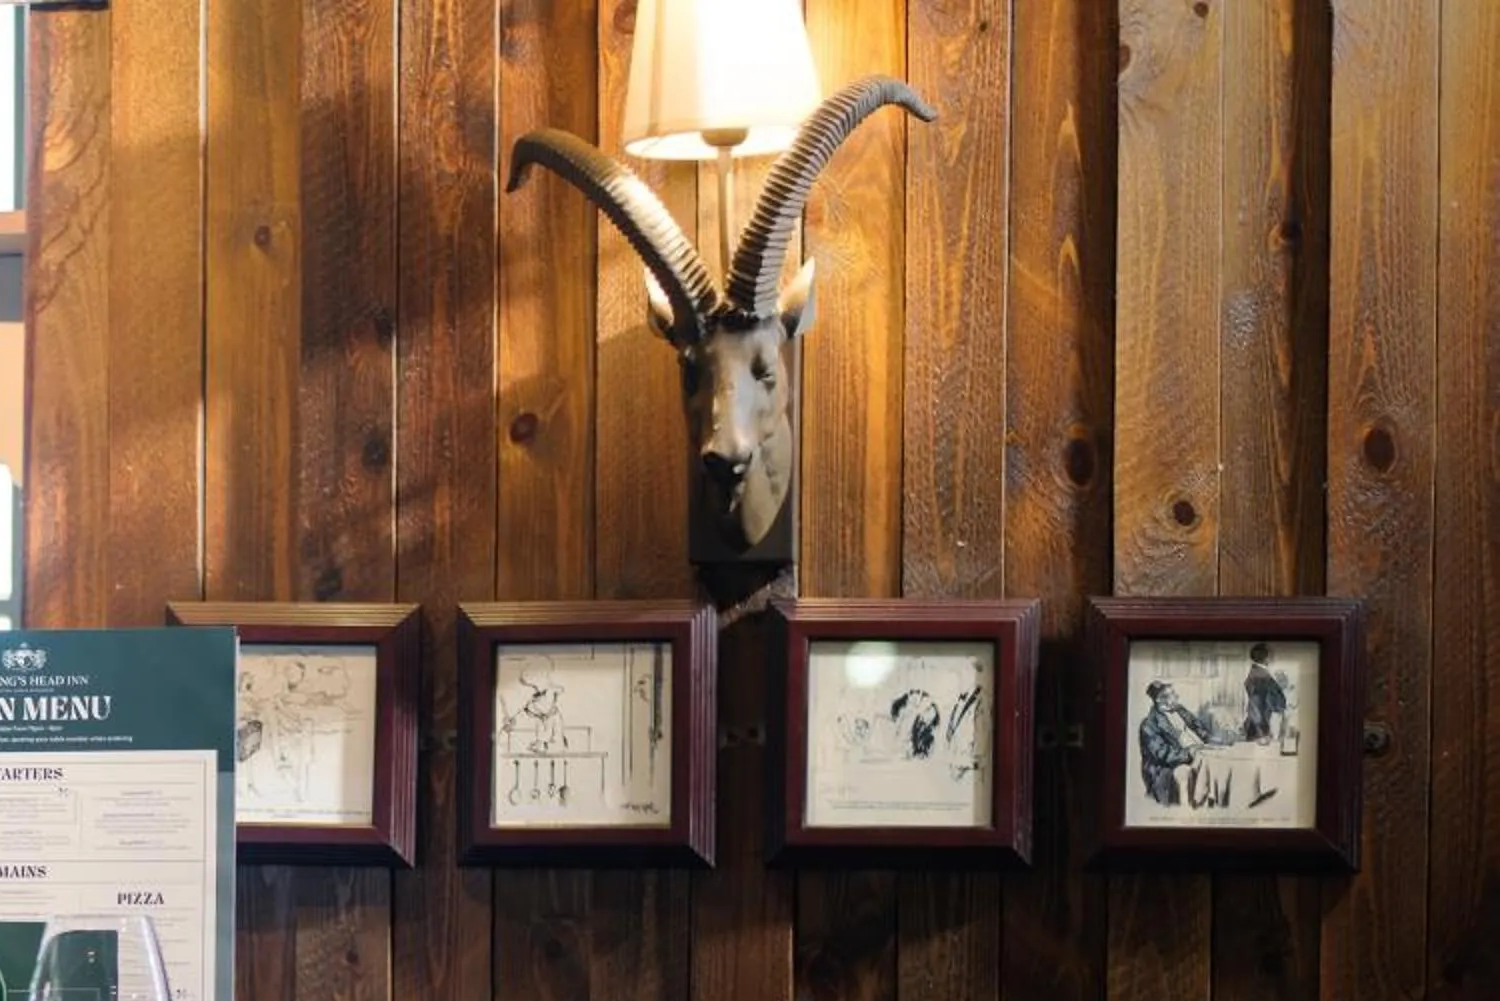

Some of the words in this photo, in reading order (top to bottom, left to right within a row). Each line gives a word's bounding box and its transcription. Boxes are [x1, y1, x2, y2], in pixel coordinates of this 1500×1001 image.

[29, 675, 65, 687] HEAD
[67, 675, 90, 687] INN
[22, 695, 112, 721] MENU
[116, 892, 166, 906] PIZZA
